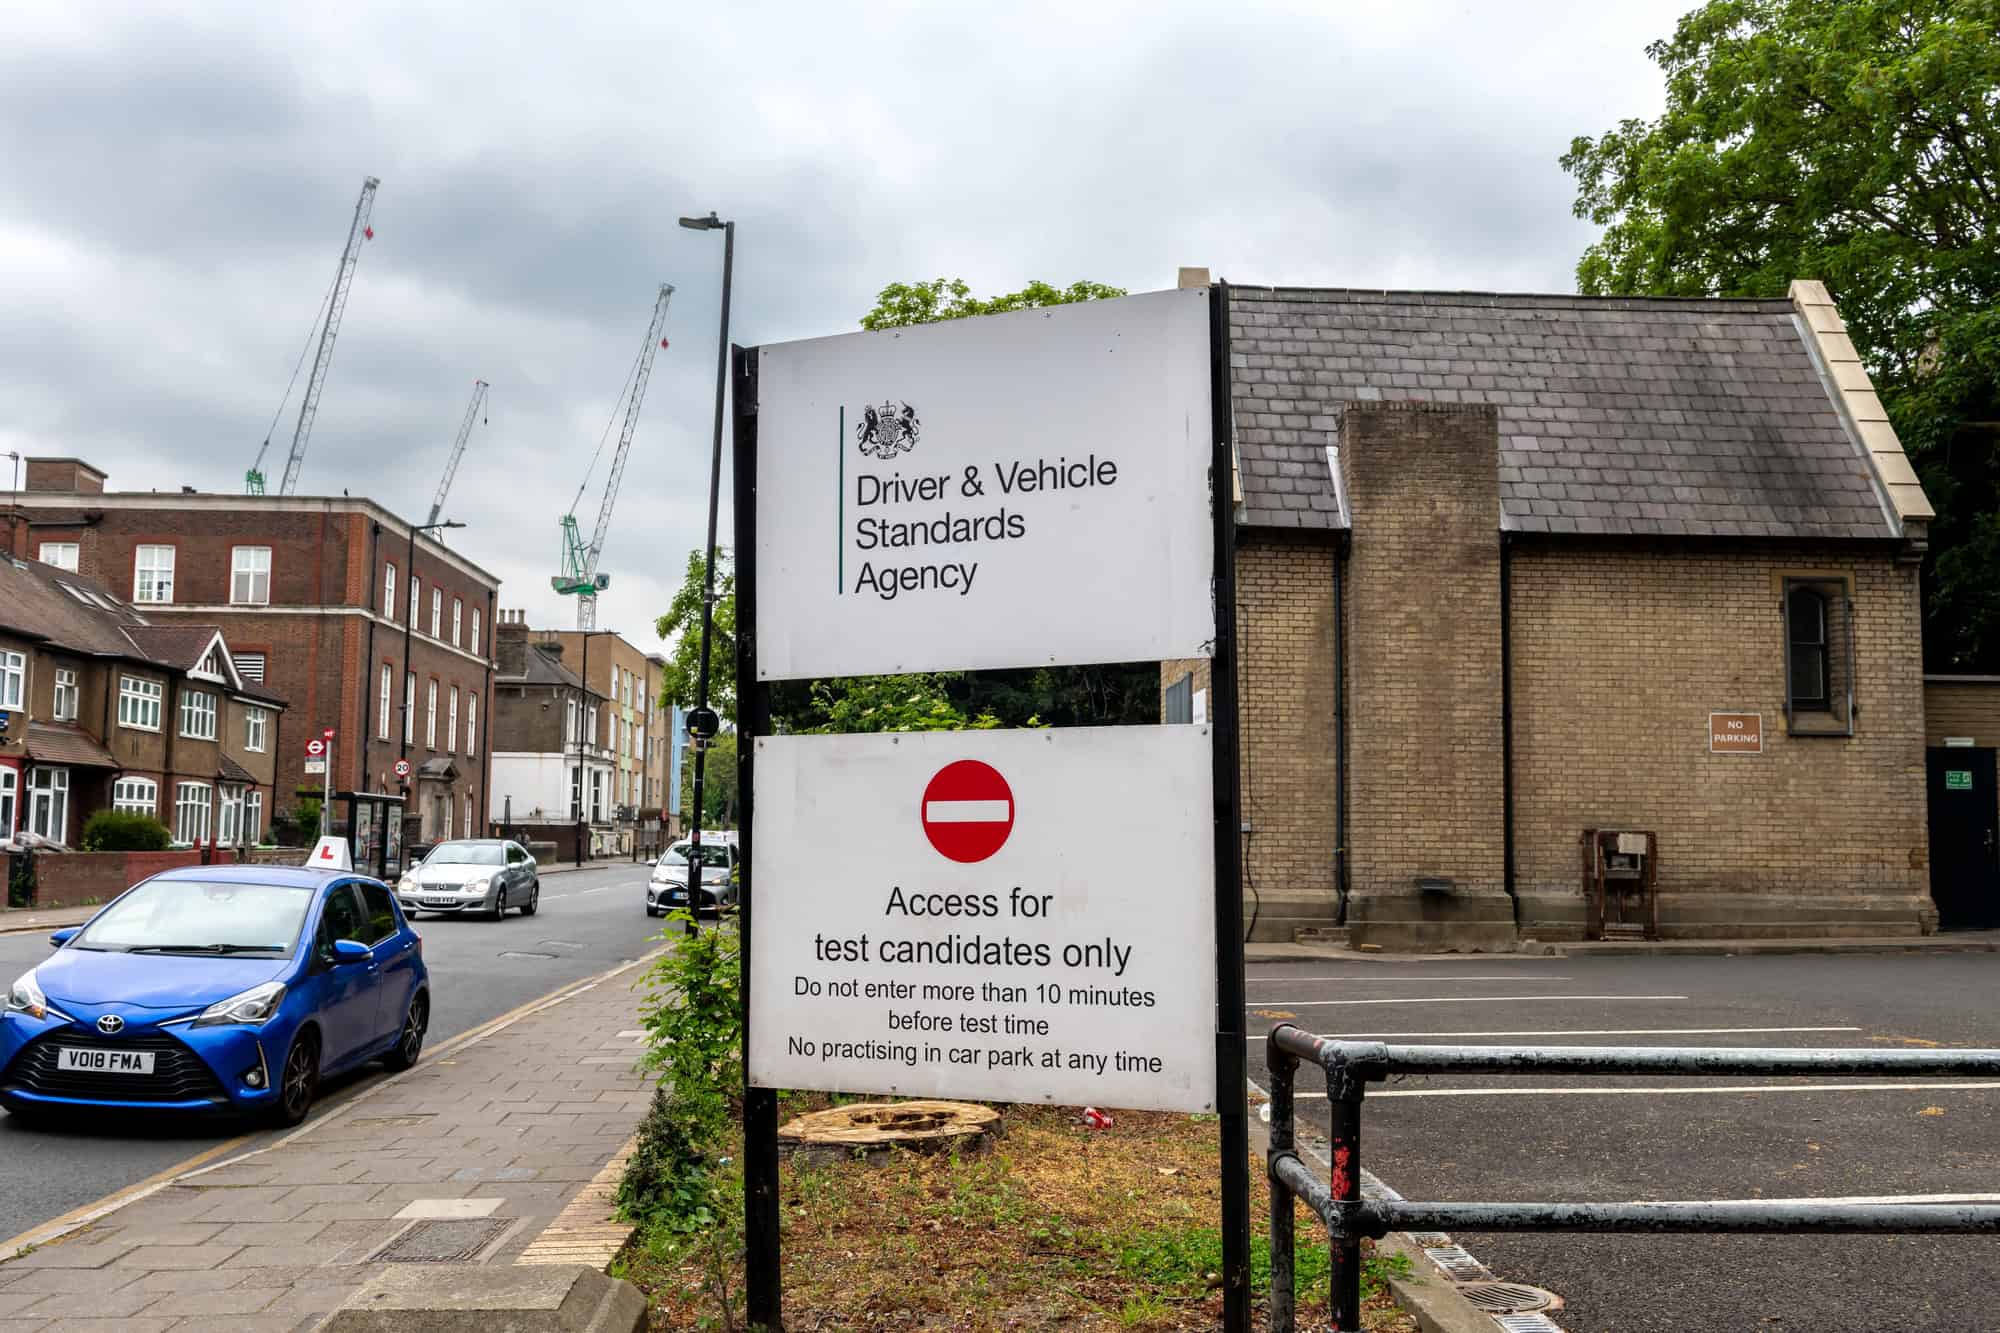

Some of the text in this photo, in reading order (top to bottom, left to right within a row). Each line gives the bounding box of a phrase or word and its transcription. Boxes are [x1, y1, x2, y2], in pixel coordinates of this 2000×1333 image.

[857, 454, 1118, 506] Driver & Vehicle
[855, 507, 1026, 550] Standards
[854, 562, 978, 601] Agency
[1714, 733, 1758, 743] PARKING
[1727, 720, 1744, 729] NO
[397, 764, 409, 772] 20
[320, 846, 334, 859] L
[885, 886, 1054, 918] Access for
[814, 933, 1132, 977] test candidates only
[794, 976, 1156, 1008] Do not enter more than 10 minutes
[888, 1009, 1049, 1036] before test time
[69, 1050, 143, 1070] VO18 FMA
[788, 1036, 1163, 1076] No practising in car park at any time
